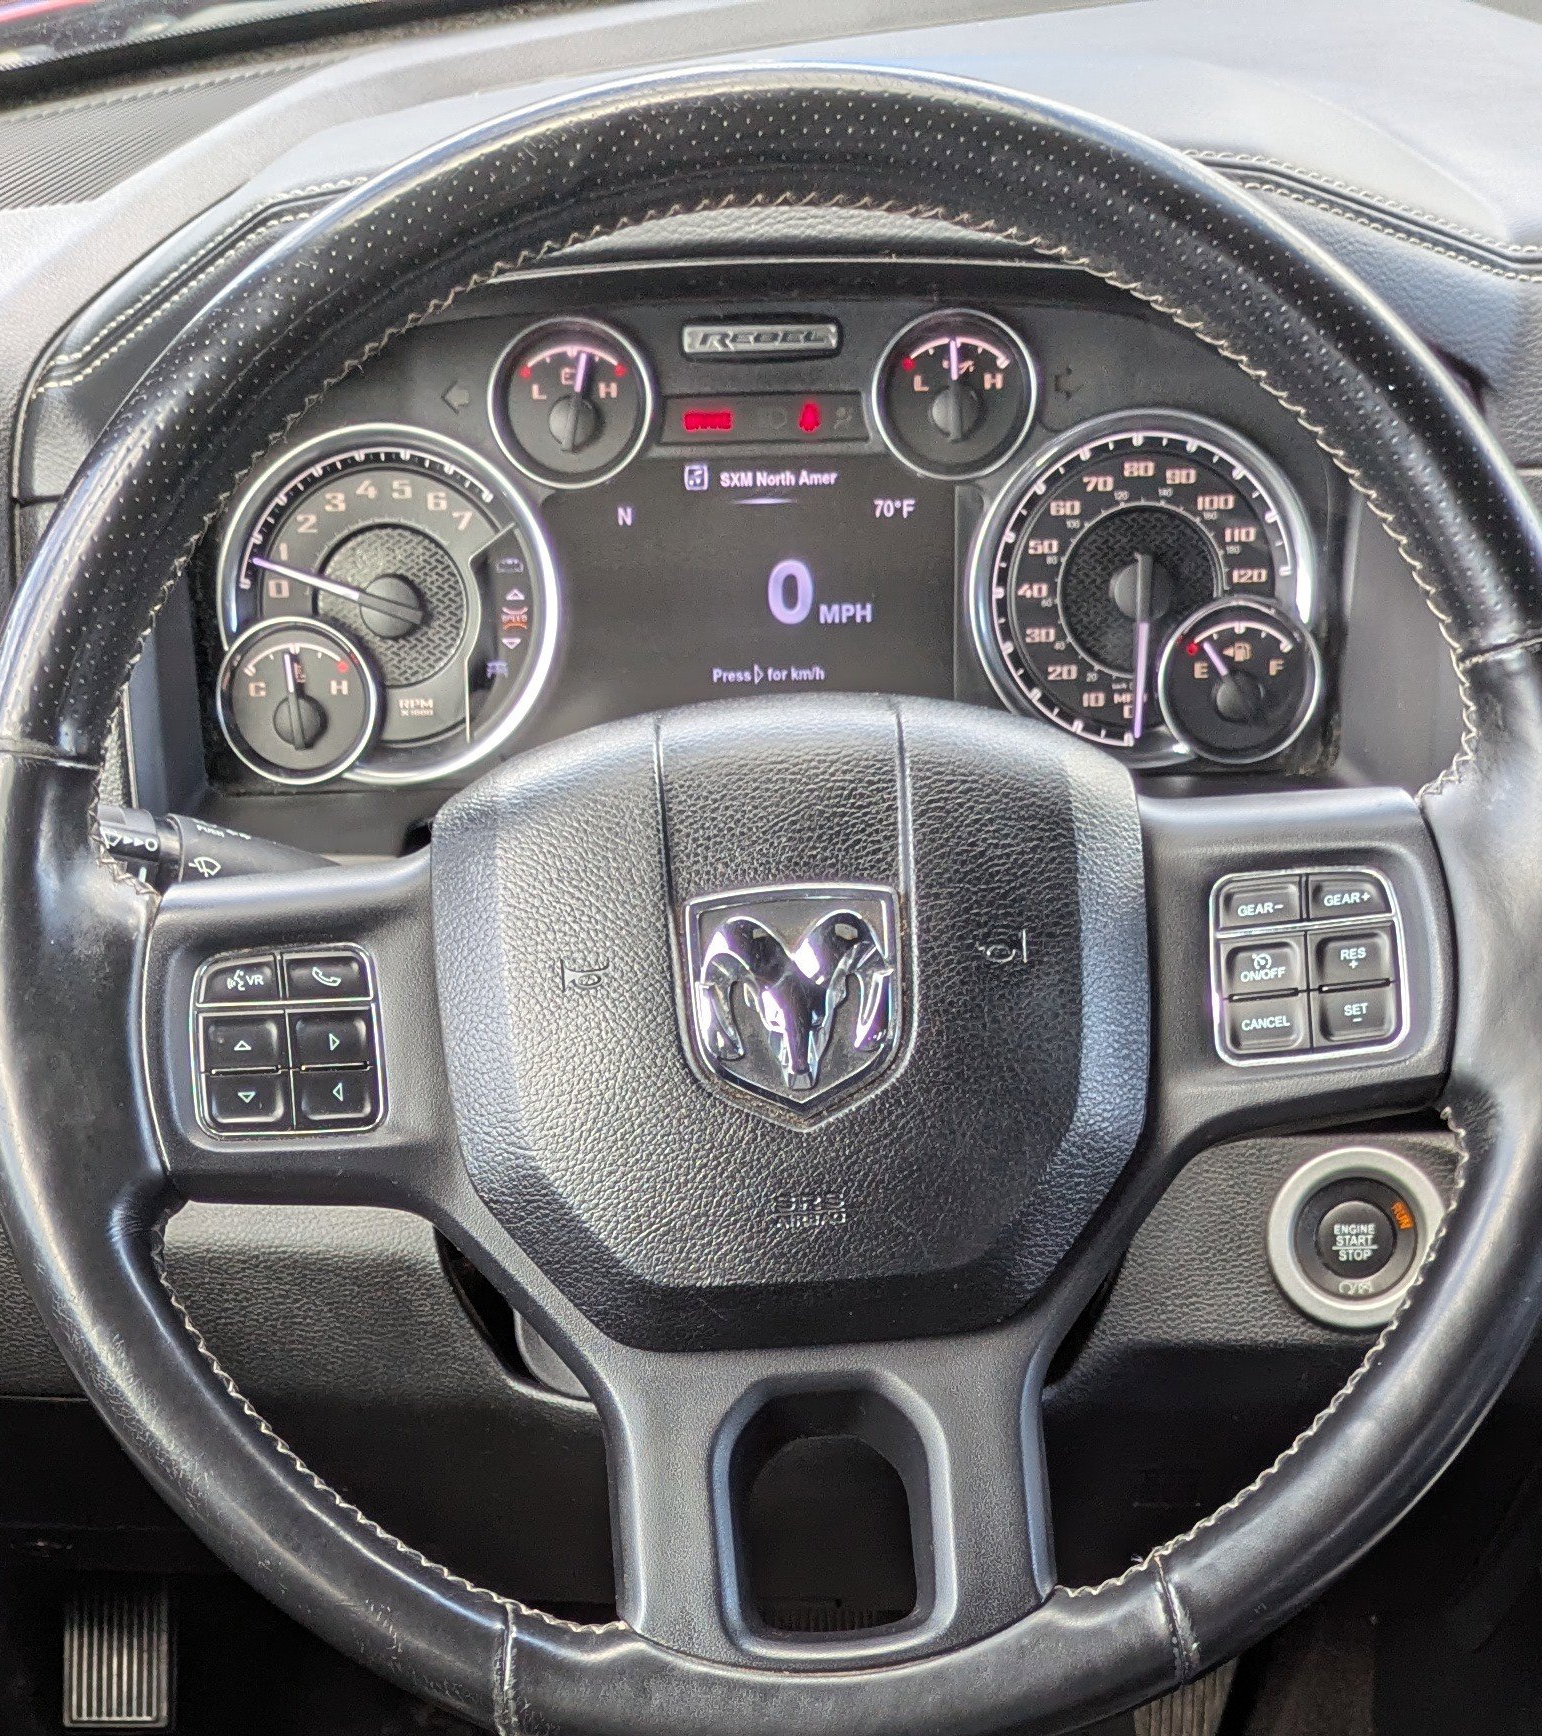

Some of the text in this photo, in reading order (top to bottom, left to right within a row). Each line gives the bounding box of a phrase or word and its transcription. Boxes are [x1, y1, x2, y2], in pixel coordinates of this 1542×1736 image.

[698, 331, 826, 350] REBEL
[914, 374, 930, 392] L
[983, 373, 1004, 390] H
[531, 384, 547, 400] L
[599, 382, 618, 399] H
[1124, 461, 1155, 477] 80
[1165, 468, 1196, 484] 90
[720, 470, 837, 487] SXM North Amer
[1082, 475, 1114, 492] 70
[355, 479, 378, 499] 4
[391, 479, 413, 500] 5
[324, 491, 346, 512] 3
[426, 491, 448, 511] 6
[873, 498, 916, 518] 70°F
[1049, 500, 1081, 516] 60
[1196, 494, 1235, 511] 100
[296, 514, 317, 534] 2
[452, 511, 473, 531] 7
[617, 506, 633, 526] N
[1224, 526, 1257, 543] 110
[279, 543, 289, 561] 1
[1028, 538, 1059, 555] 50
[1232, 567, 1268, 583] 120
[268, 579, 290, 599] 0
[767, 559, 873, 625] 0 MPH
[1017, 582, 1049, 599] 40
[1025, 627, 1056, 644] 30
[712, 664, 826, 683] Press for km/h
[1047, 664, 1078, 680] 20
[1193, 661, 1209, 679] E
[1269, 658, 1285, 676] F
[330, 680, 349, 696] H
[398, 699, 434, 709] RPM
[1081, 692, 1106, 708] 10
[1339, 946, 1367, 961] RES
[245, 973, 264, 986] VR
[1240, 966, 1287, 983] ON/OFF
[1344, 1003, 1369, 1017] SET
[1241, 1015, 1291, 1032] CANCEL
[1390, 1200, 1414, 1230] RUN
[1333, 1222, 1376, 1235] ENGINE
[1335, 1234, 1374, 1246] START
[1338, 1249, 1373, 1262] STOP
